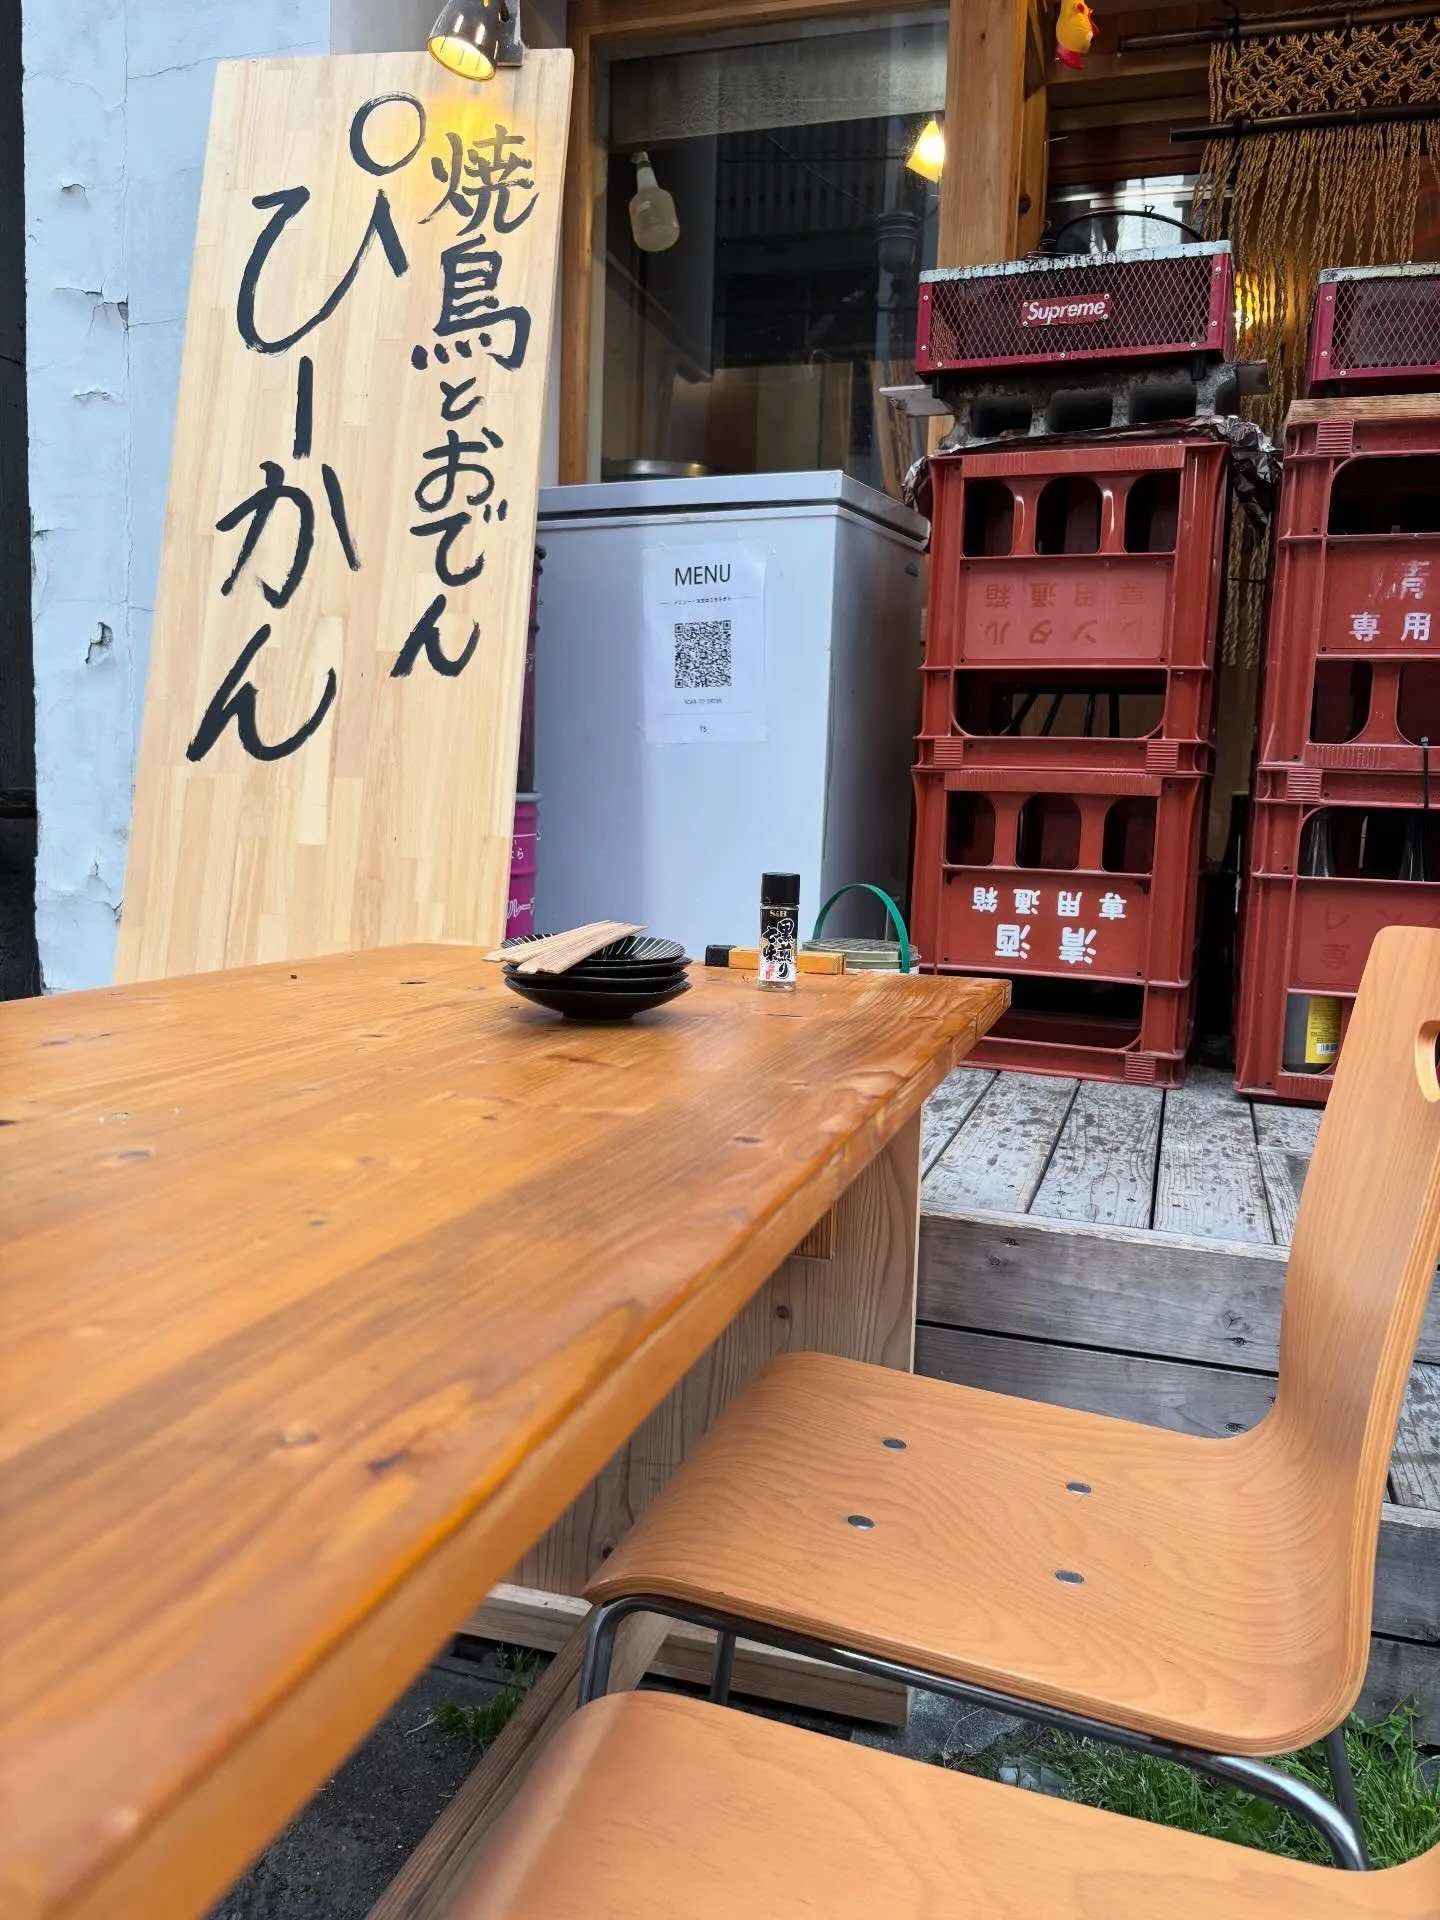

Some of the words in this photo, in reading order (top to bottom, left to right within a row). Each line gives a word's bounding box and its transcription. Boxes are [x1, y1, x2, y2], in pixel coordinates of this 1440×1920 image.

[1027, 301, 1105, 325] Supreme
[389, 123, 540, 678] 焼鳥とおでん
[186, 91, 427, 762] ぴーかん
[675, 563, 731, 586] MENU
[1348, 611, 1431, 642] 専用
[769, 910, 788, 918] S&B
[971, 886, 1127, 920] 専用通箱
[776, 918, 795, 979] 黒煎り
[994, 923, 1097, 964] 清酒
